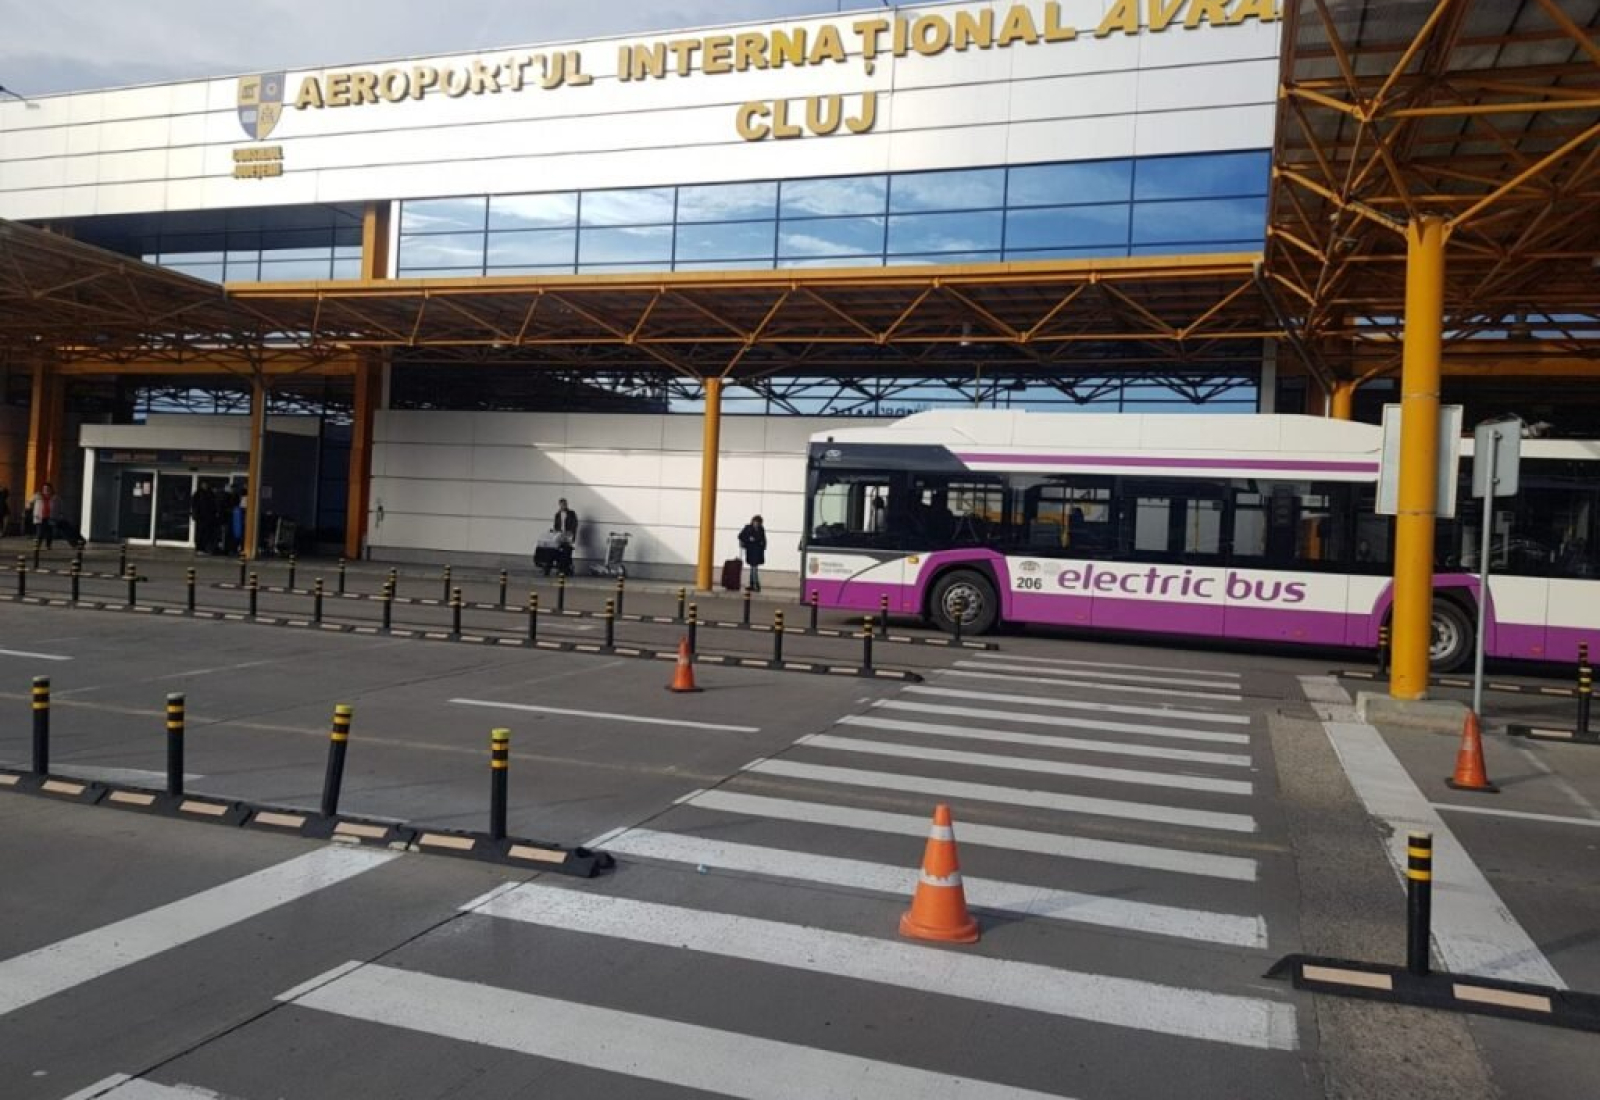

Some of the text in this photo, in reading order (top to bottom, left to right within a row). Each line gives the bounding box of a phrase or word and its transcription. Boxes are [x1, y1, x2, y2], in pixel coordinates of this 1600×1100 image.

[294, 0, 1281, 110] AEROPORTUL INTERNAȚIONAL AVRA
[735, 92, 878, 141] CLUJ
[1016, 577, 1043, 590] 206
[1058, 563, 1307, 603] electric bus
